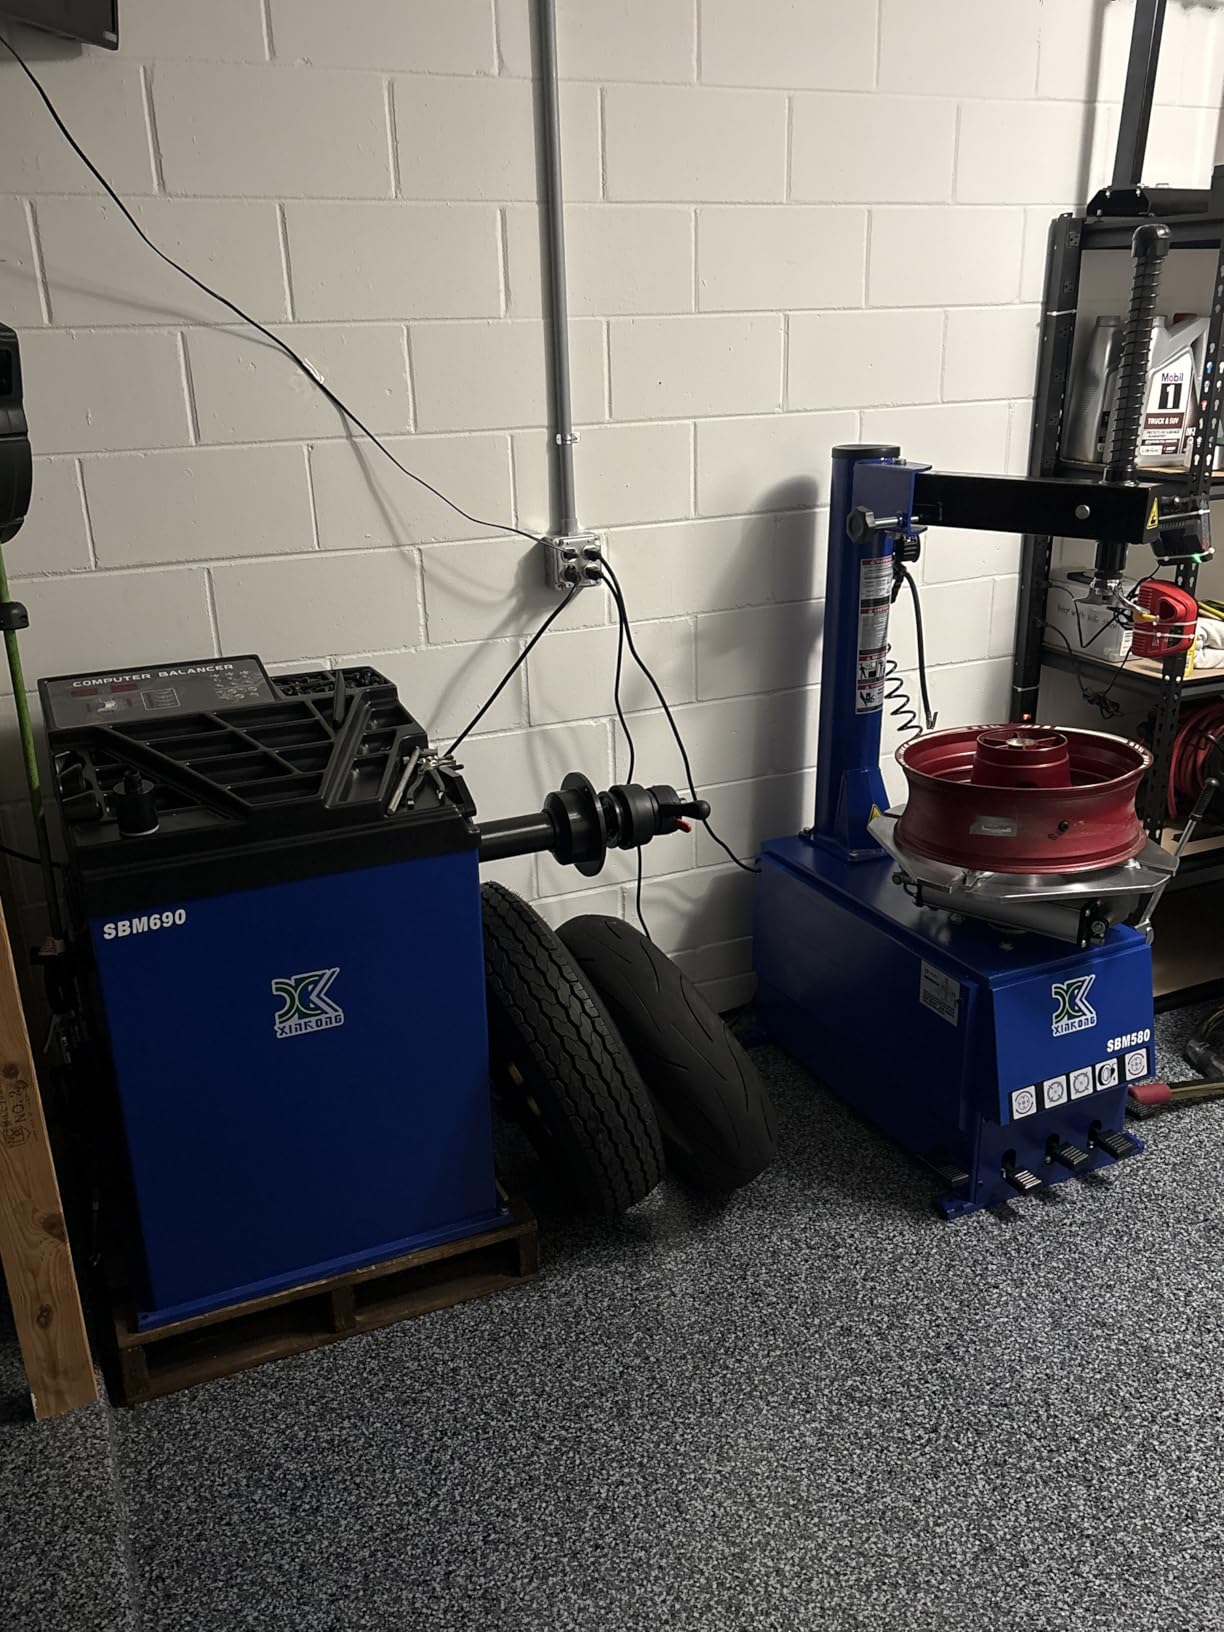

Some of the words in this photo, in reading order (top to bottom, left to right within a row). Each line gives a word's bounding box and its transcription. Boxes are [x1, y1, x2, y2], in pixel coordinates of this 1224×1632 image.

[1161, 373, 1184, 382] Mobil
[1166, 384, 1175, 409] 1
[1147, 417, 1165, 425] TRUCK
[1169, 417, 1180, 425] SUV
[73, 673, 150, 687] COMPUTER
[158, 664, 233, 677] BALANCER
[103, 908, 187, 940] SBM690
[1106, 1028, 1151, 1052] SBM580
